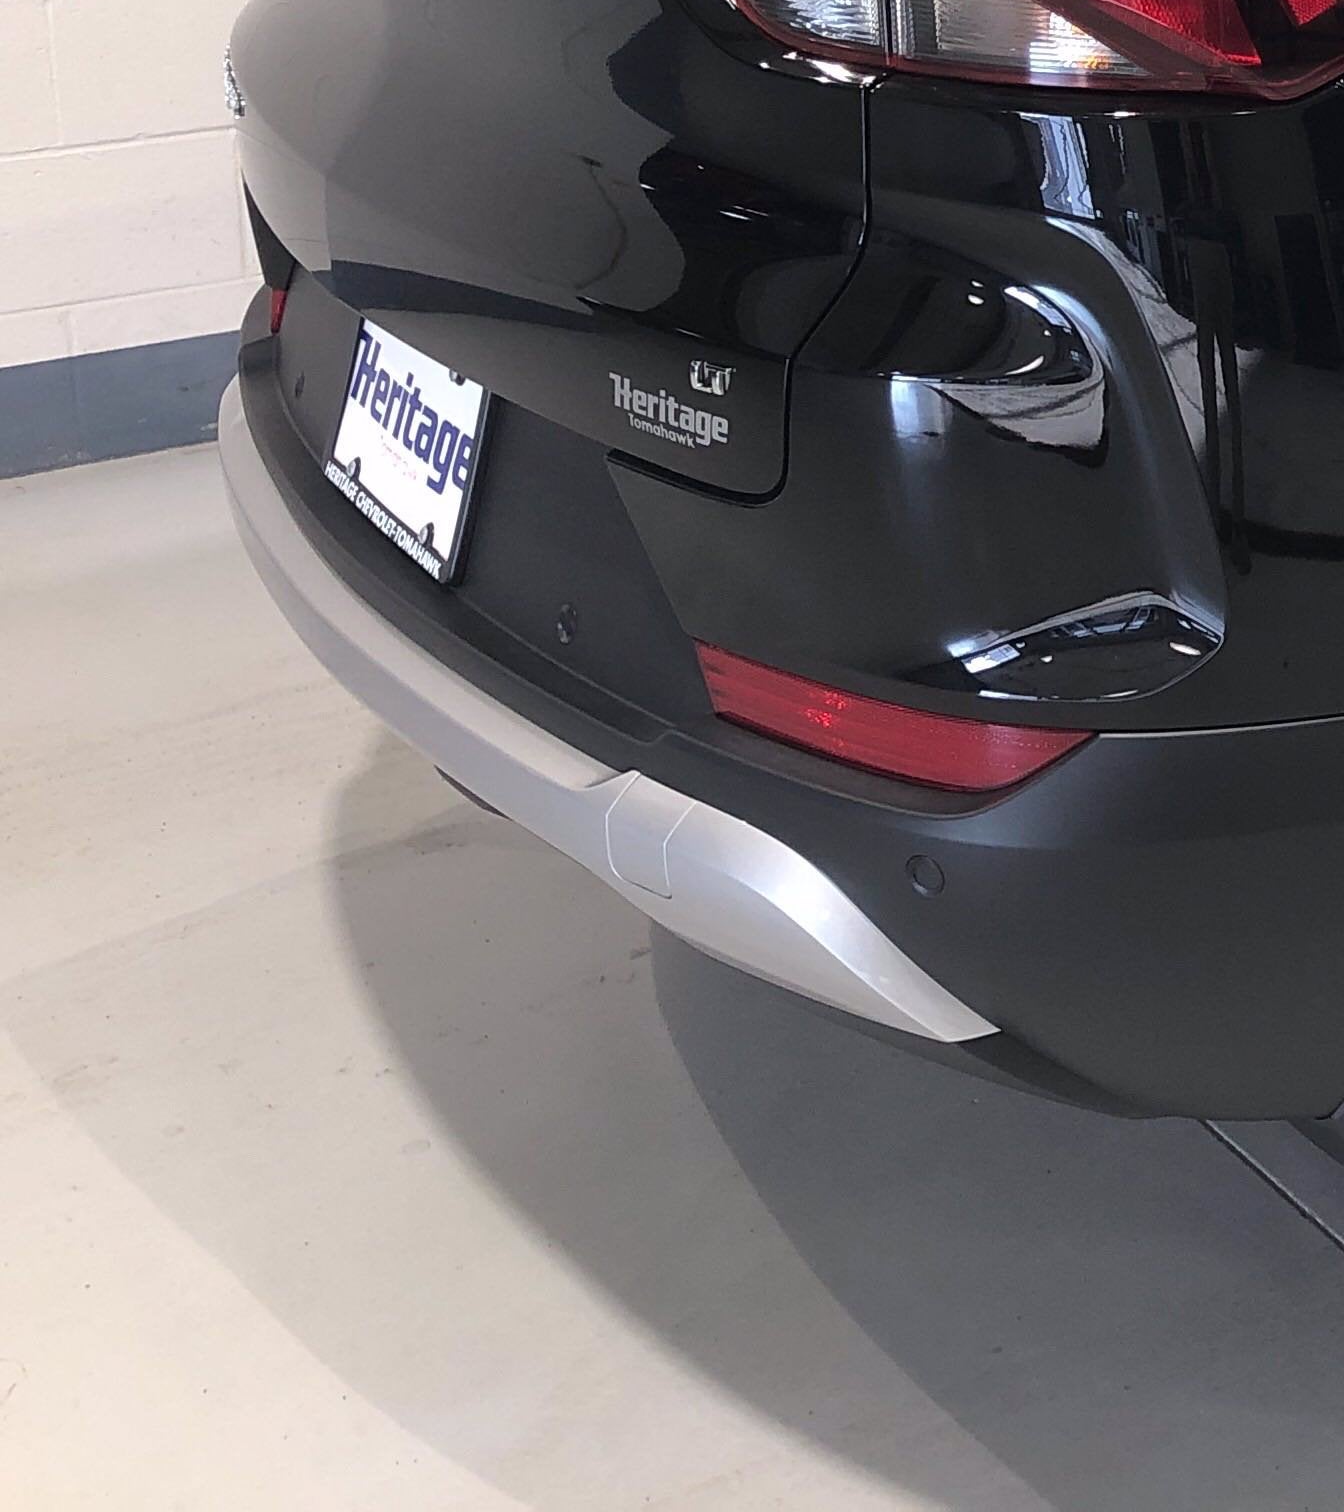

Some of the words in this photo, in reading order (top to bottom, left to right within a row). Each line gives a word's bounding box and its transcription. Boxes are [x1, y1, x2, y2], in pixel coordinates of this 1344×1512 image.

[351, 327, 475, 495] Heritage
[609, 372, 729, 447] Heritage
[628, 413, 696, 449] Tomahawk
[325, 460, 359, 503] HERITAGE
